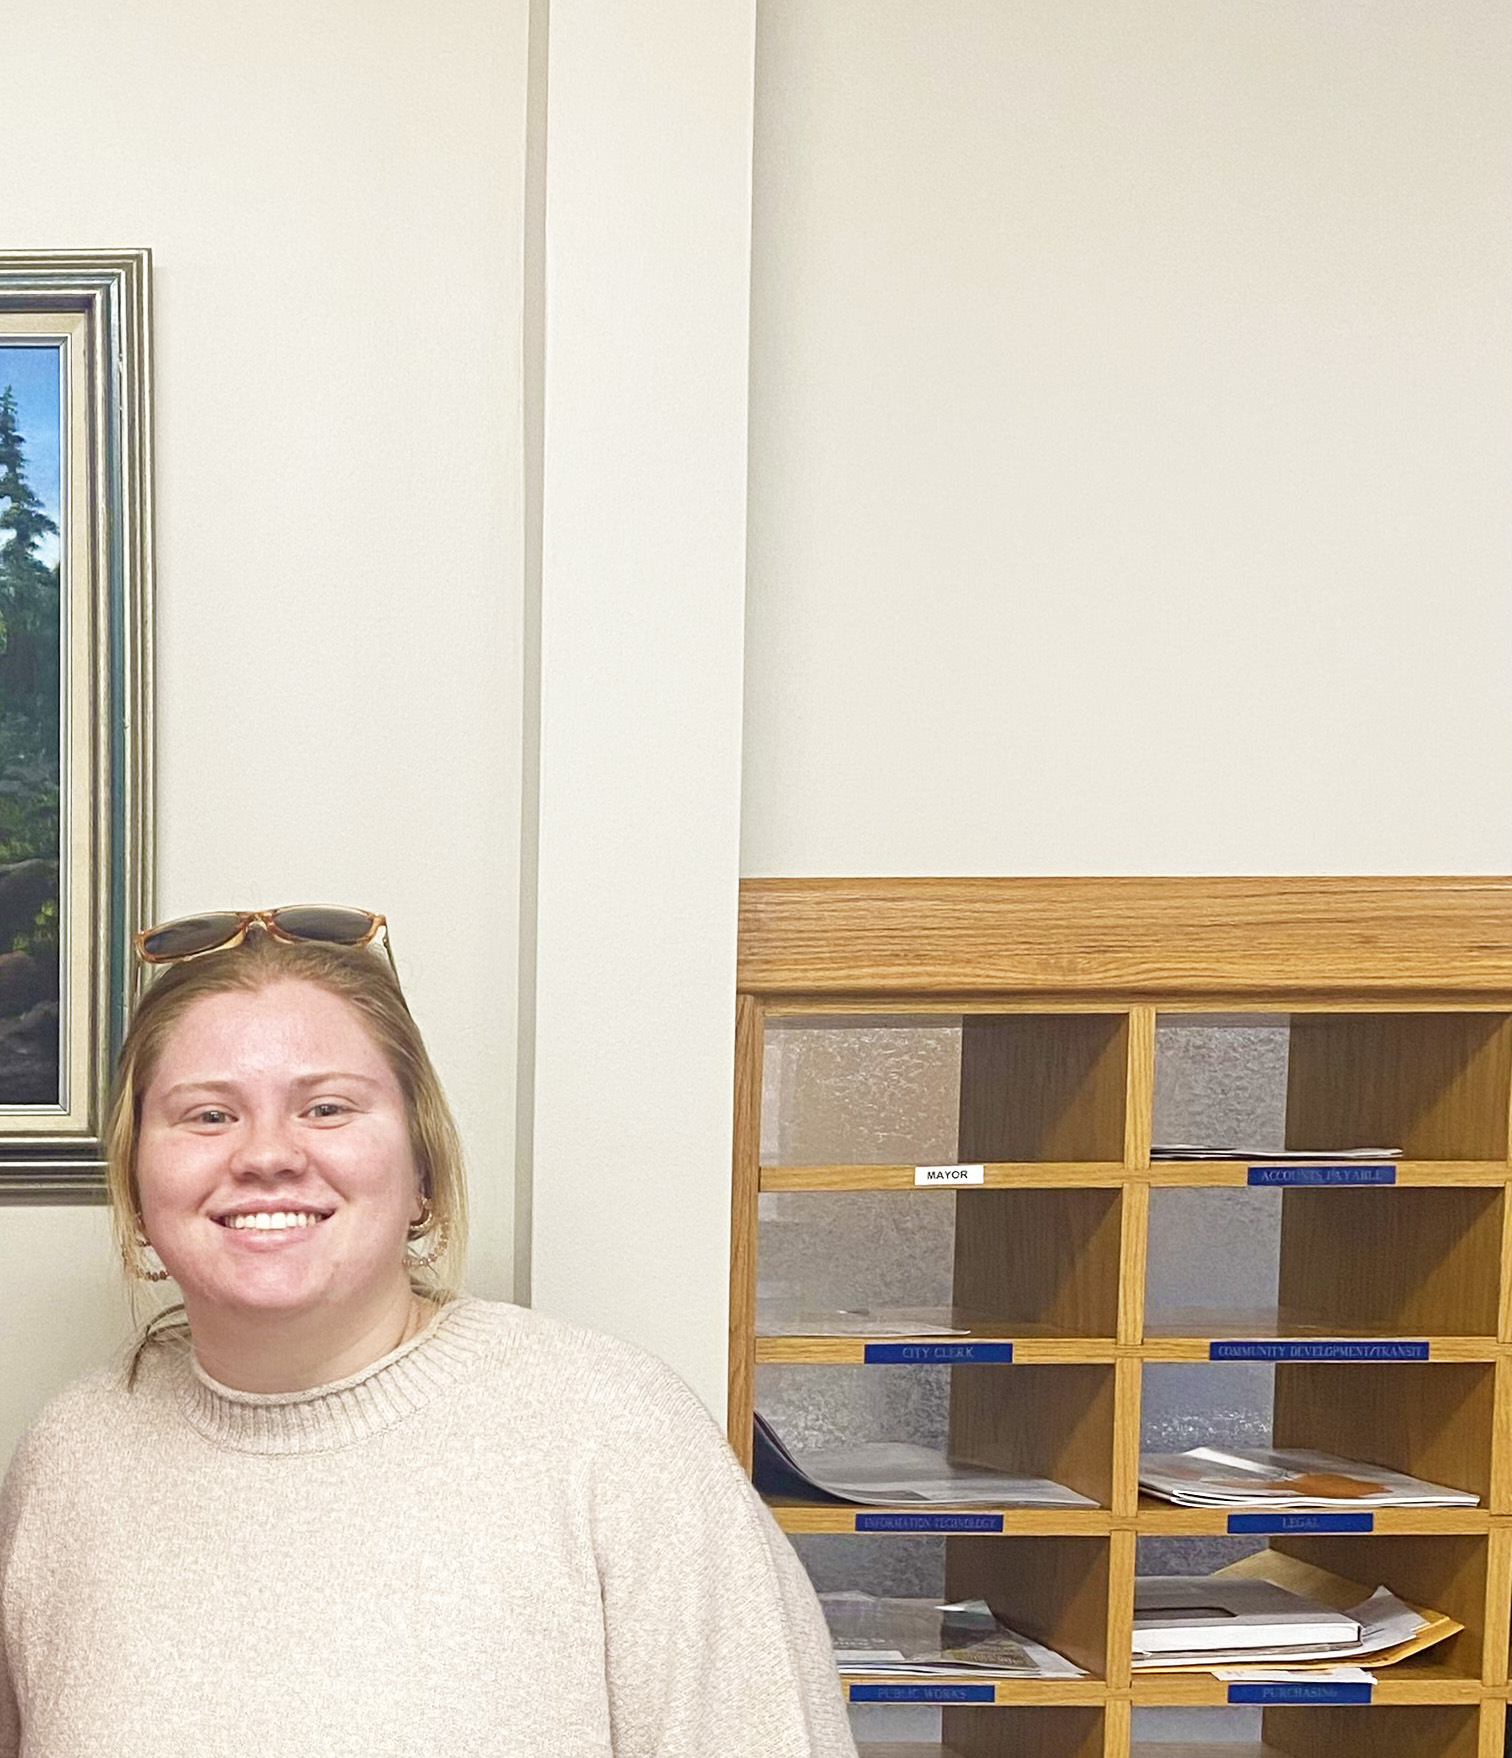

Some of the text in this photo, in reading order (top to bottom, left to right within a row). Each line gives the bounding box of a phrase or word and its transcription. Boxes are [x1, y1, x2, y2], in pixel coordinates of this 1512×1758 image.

[926, 1169, 969, 1180] MAYOR
[902, 1347, 974, 1359] CITY CLERK
[1218, 1345, 1422, 1357] COMMUNITY DEVELOPMENT/TRANSIT
[864, 1517, 996, 1529] INFORMATION TECHNOLOGY
[1282, 1516, 1320, 1528] LEGAL
[877, 1687, 968, 1699] PUBLIC WORKS
[1262, 1686, 1337, 1698] PURCHASING
